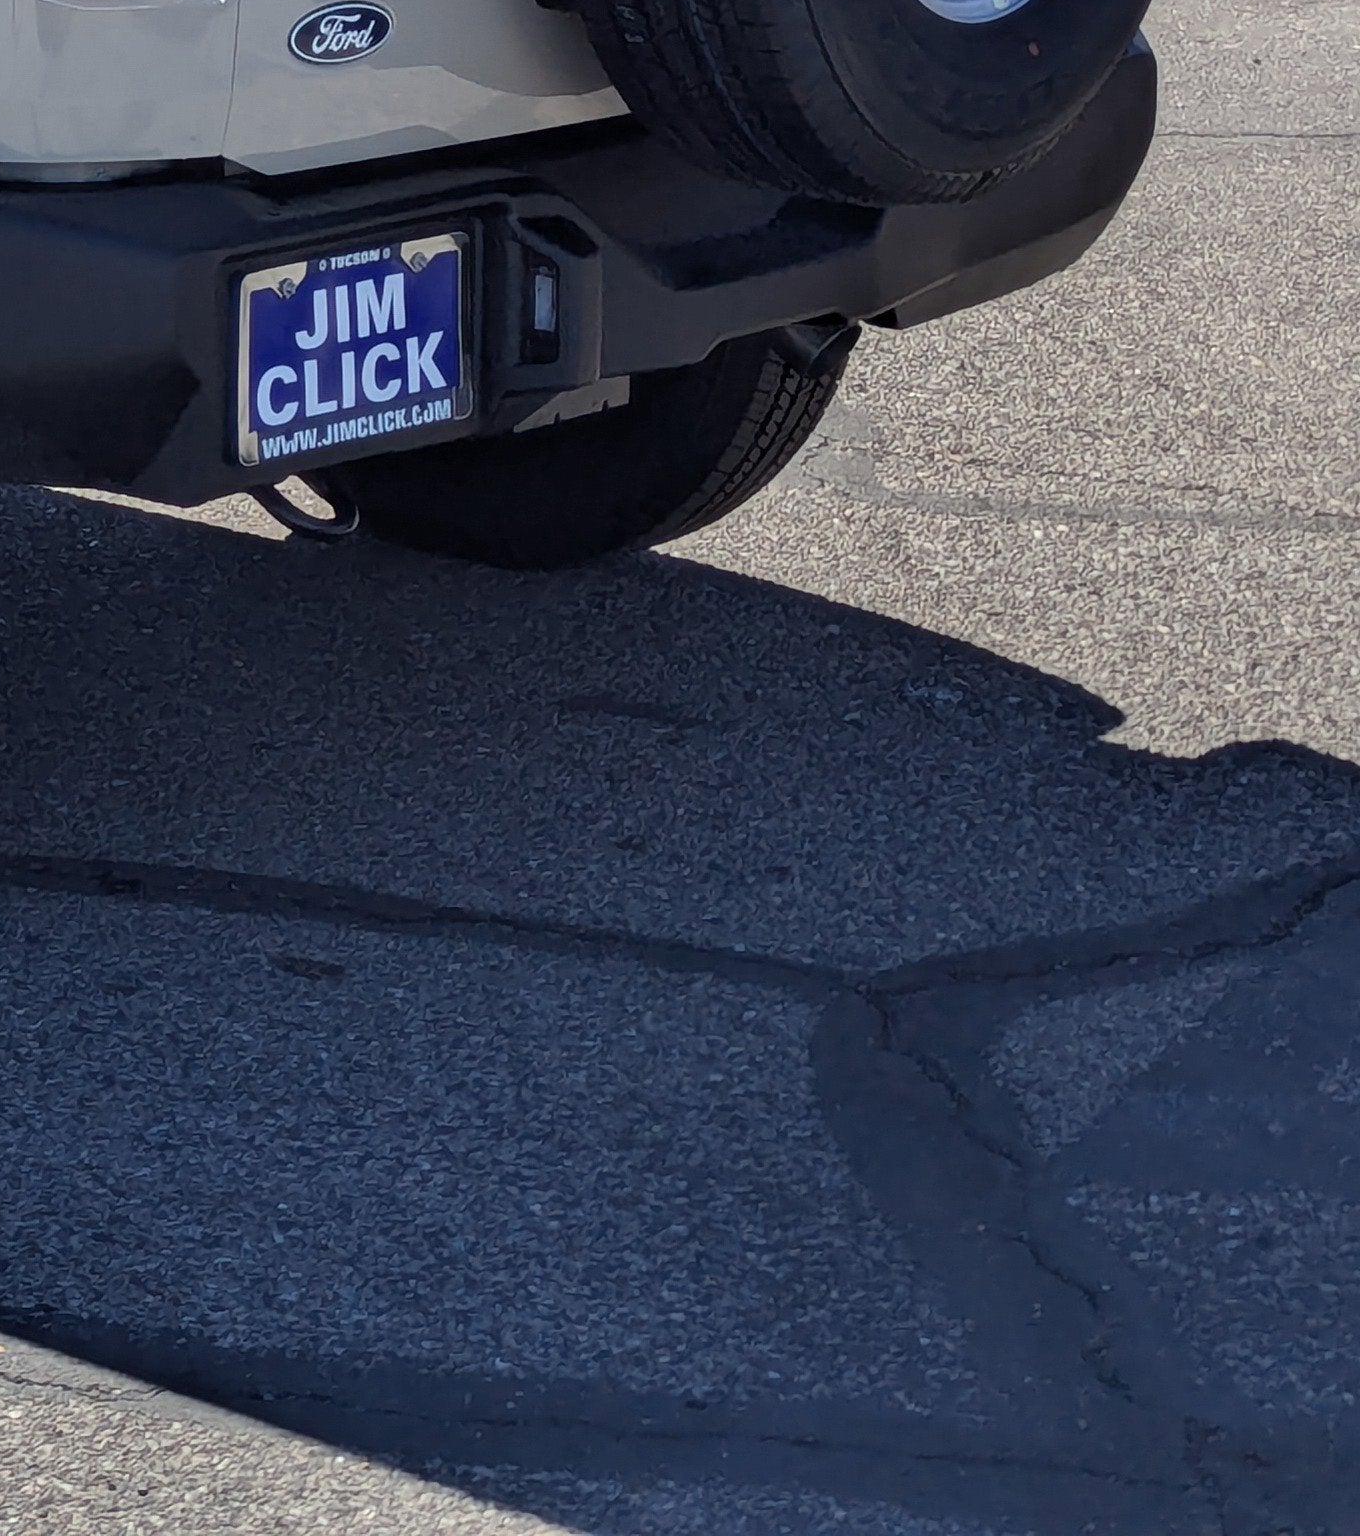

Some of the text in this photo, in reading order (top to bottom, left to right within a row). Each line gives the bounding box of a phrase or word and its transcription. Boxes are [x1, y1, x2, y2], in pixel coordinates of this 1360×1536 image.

[312, 14, 374, 54] Ford
[330, 249, 380, 270] TUCSON
[295, 273, 406, 350] JIM
[256, 331, 447, 427] CLICK
[262, 398, 451, 459] WWW.JIMCLICK.COM
